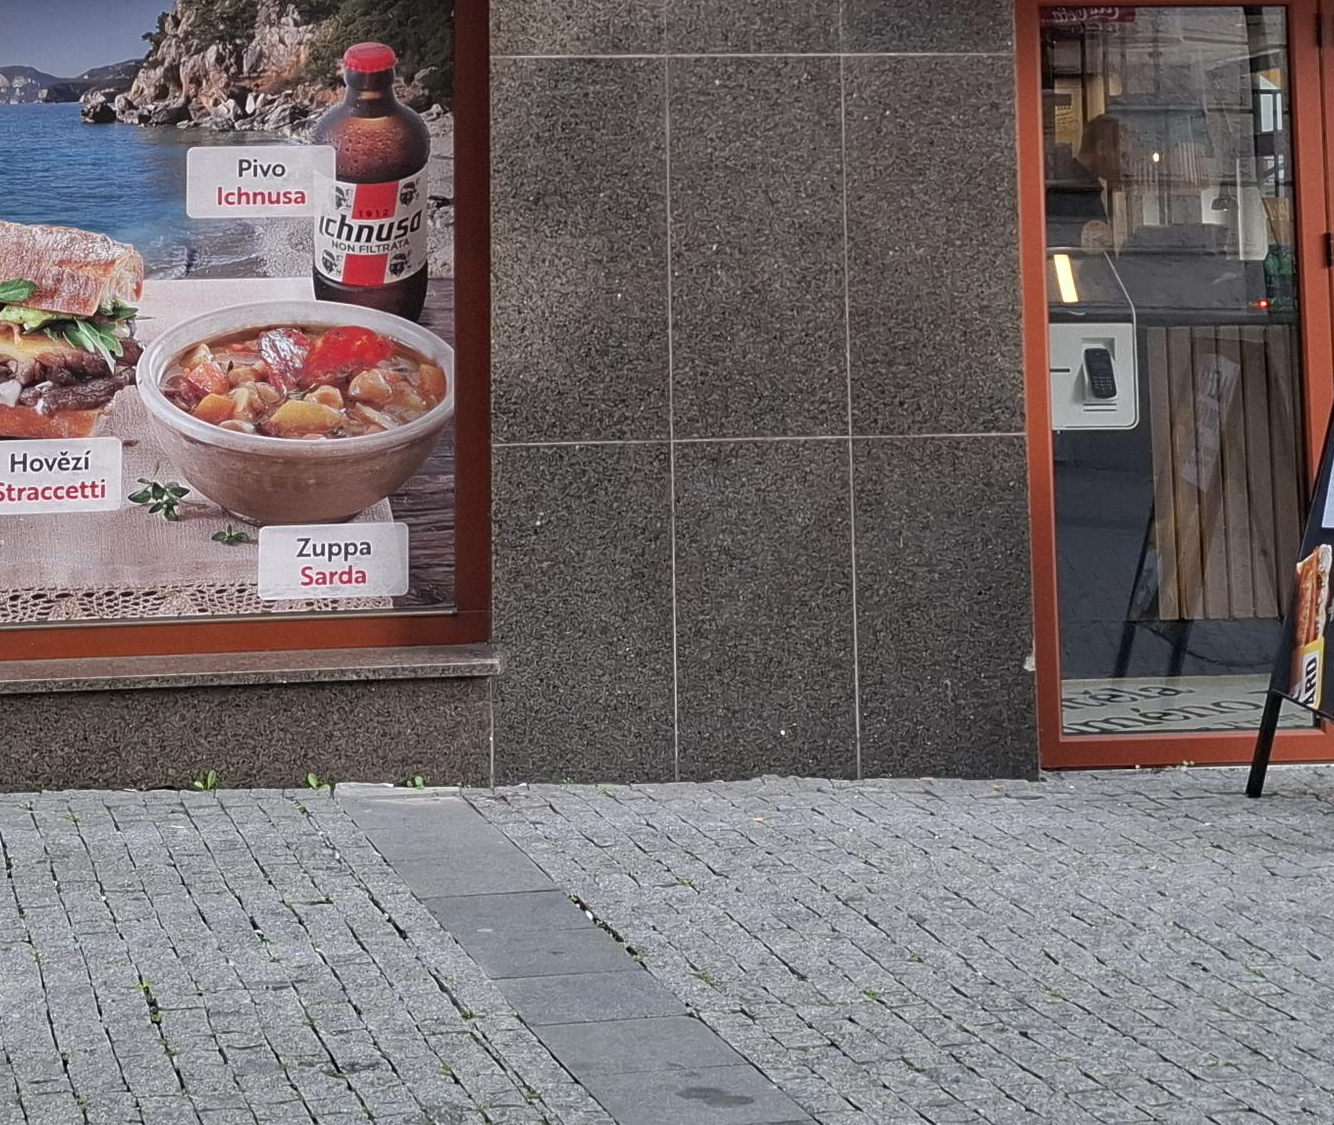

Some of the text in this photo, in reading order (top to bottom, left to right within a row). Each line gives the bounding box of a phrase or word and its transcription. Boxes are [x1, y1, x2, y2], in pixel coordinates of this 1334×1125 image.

[237, 159, 286, 178] Pivo
[217, 187, 307, 206] Ichnusa
[359, 209, 389, 218] 1912
[332, 238, 410, 254] NON FILTRATA
[9, 449, 91, 473] Hovězí
[296, 537, 372, 561] Zuppa
[300, 565, 368, 587] Sarda
